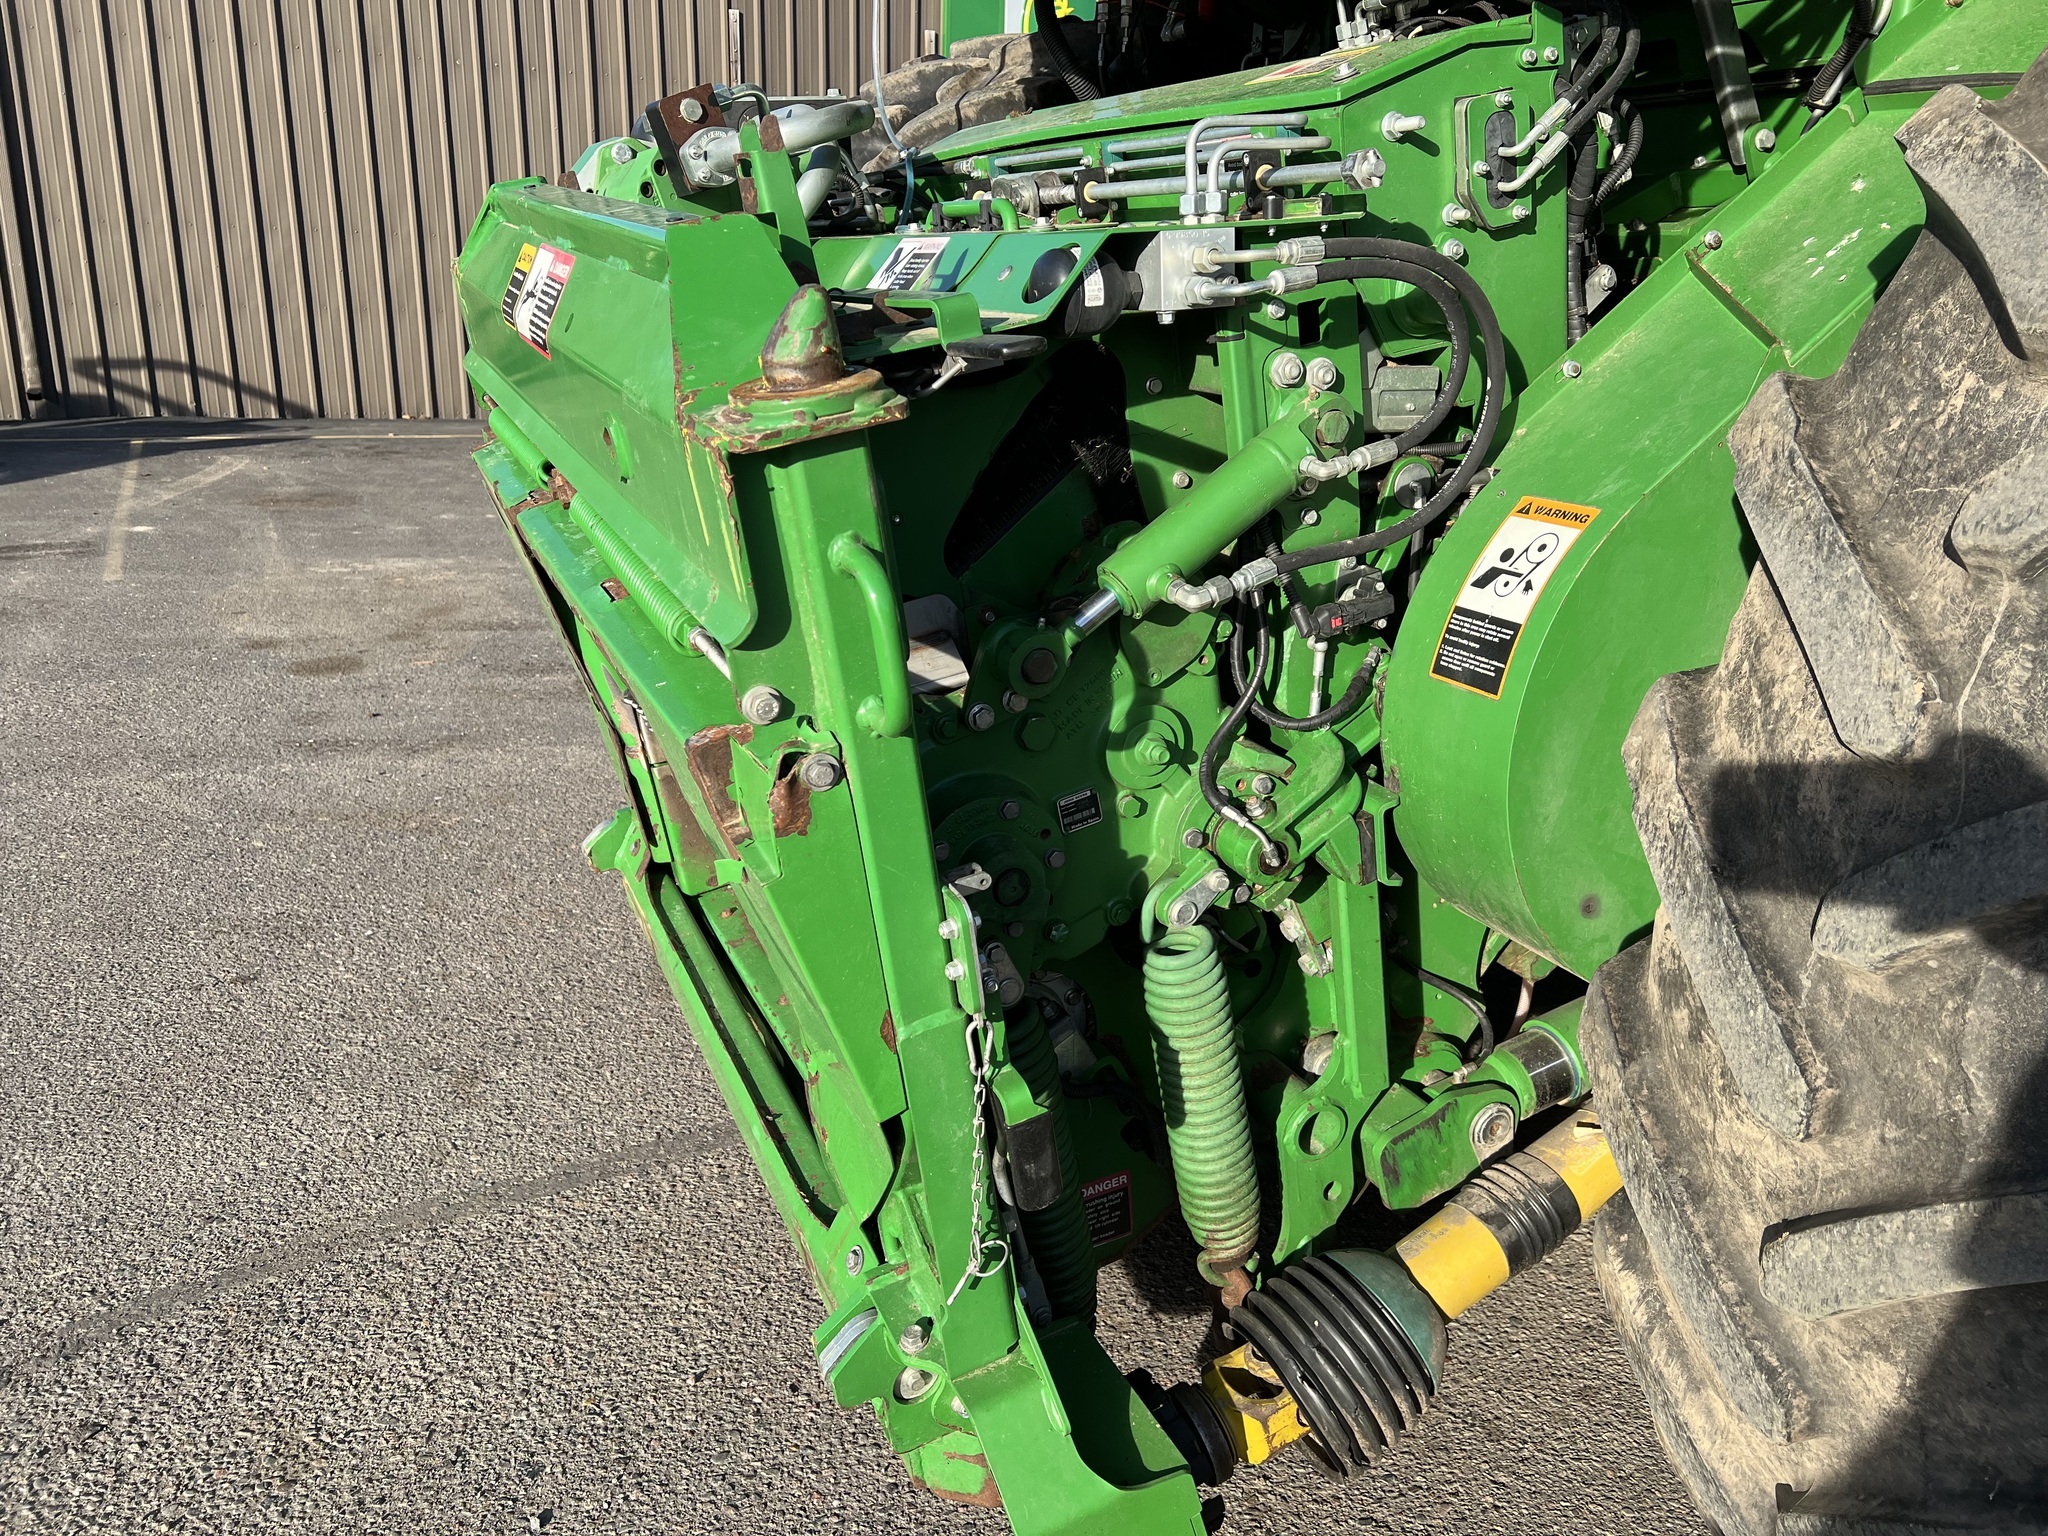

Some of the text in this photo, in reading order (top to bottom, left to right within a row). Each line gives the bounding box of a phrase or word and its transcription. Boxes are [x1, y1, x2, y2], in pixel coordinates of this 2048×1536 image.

[1534, 504, 1590, 524] WARNING
[1082, 1175, 1128, 1198] DANGER
[1084, 1196, 1107, 1207] rushing
